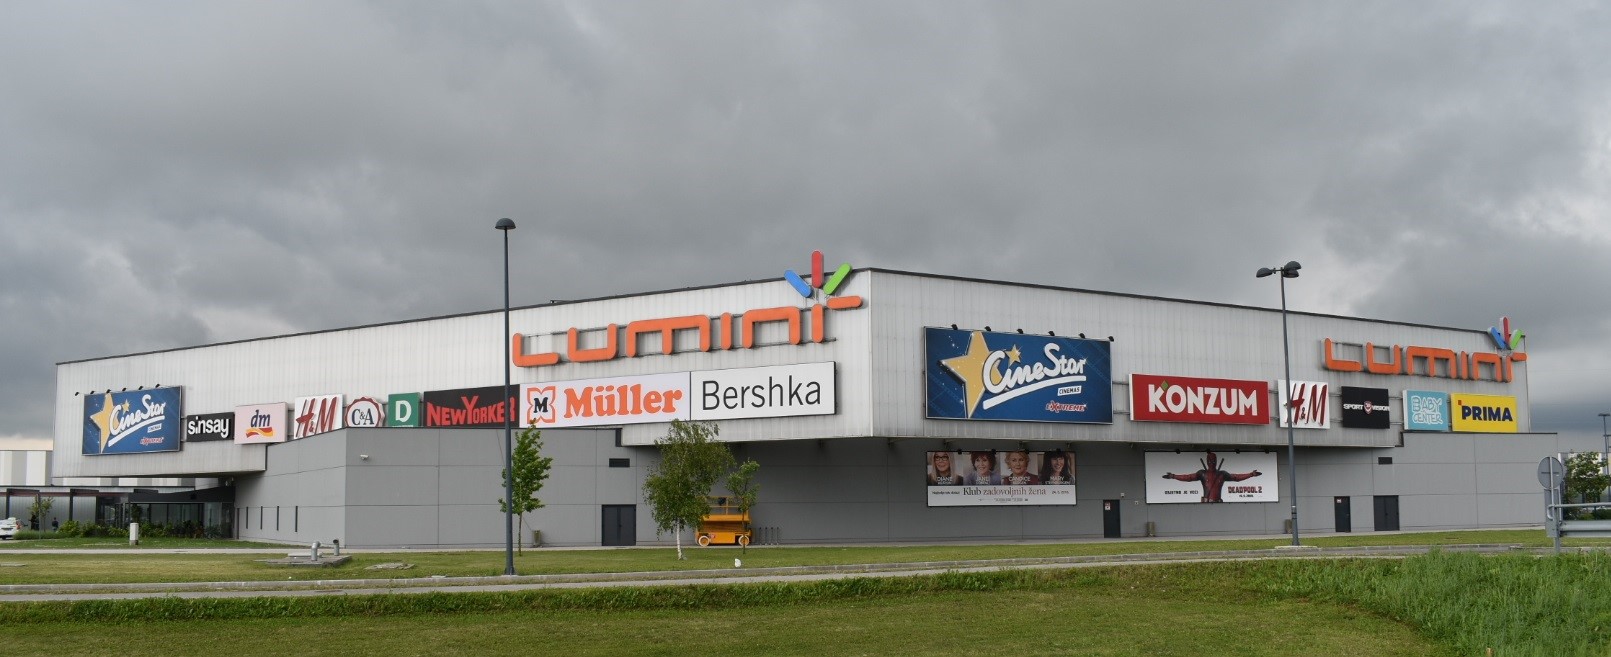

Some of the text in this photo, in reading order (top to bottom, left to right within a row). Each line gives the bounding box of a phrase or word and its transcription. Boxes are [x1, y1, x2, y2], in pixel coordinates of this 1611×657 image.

[982, 342, 1087, 394] CineStar
[533, 383, 683, 419] M Müller
[701, 375, 822, 411] Bershka
[1148, 382, 1258, 416] KONZUM
[1283, 383, 1328, 426] H&M
[1411, 395, 1442, 412] BABY
[109, 394, 167, 435] CineStar
[187, 416, 230, 438] sinsay
[250, 409, 271, 428] dm
[296, 397, 337, 437] H&M
[351, 408, 375, 426] C&A
[1412, 411, 1443, 425] CENTER
[1461, 405, 1513, 422] PRIMA
[963, 487, 982, 495] Klub
[983, 487, 1027, 497] zadovoljnih
[1028, 487, 1047, 495] žena
